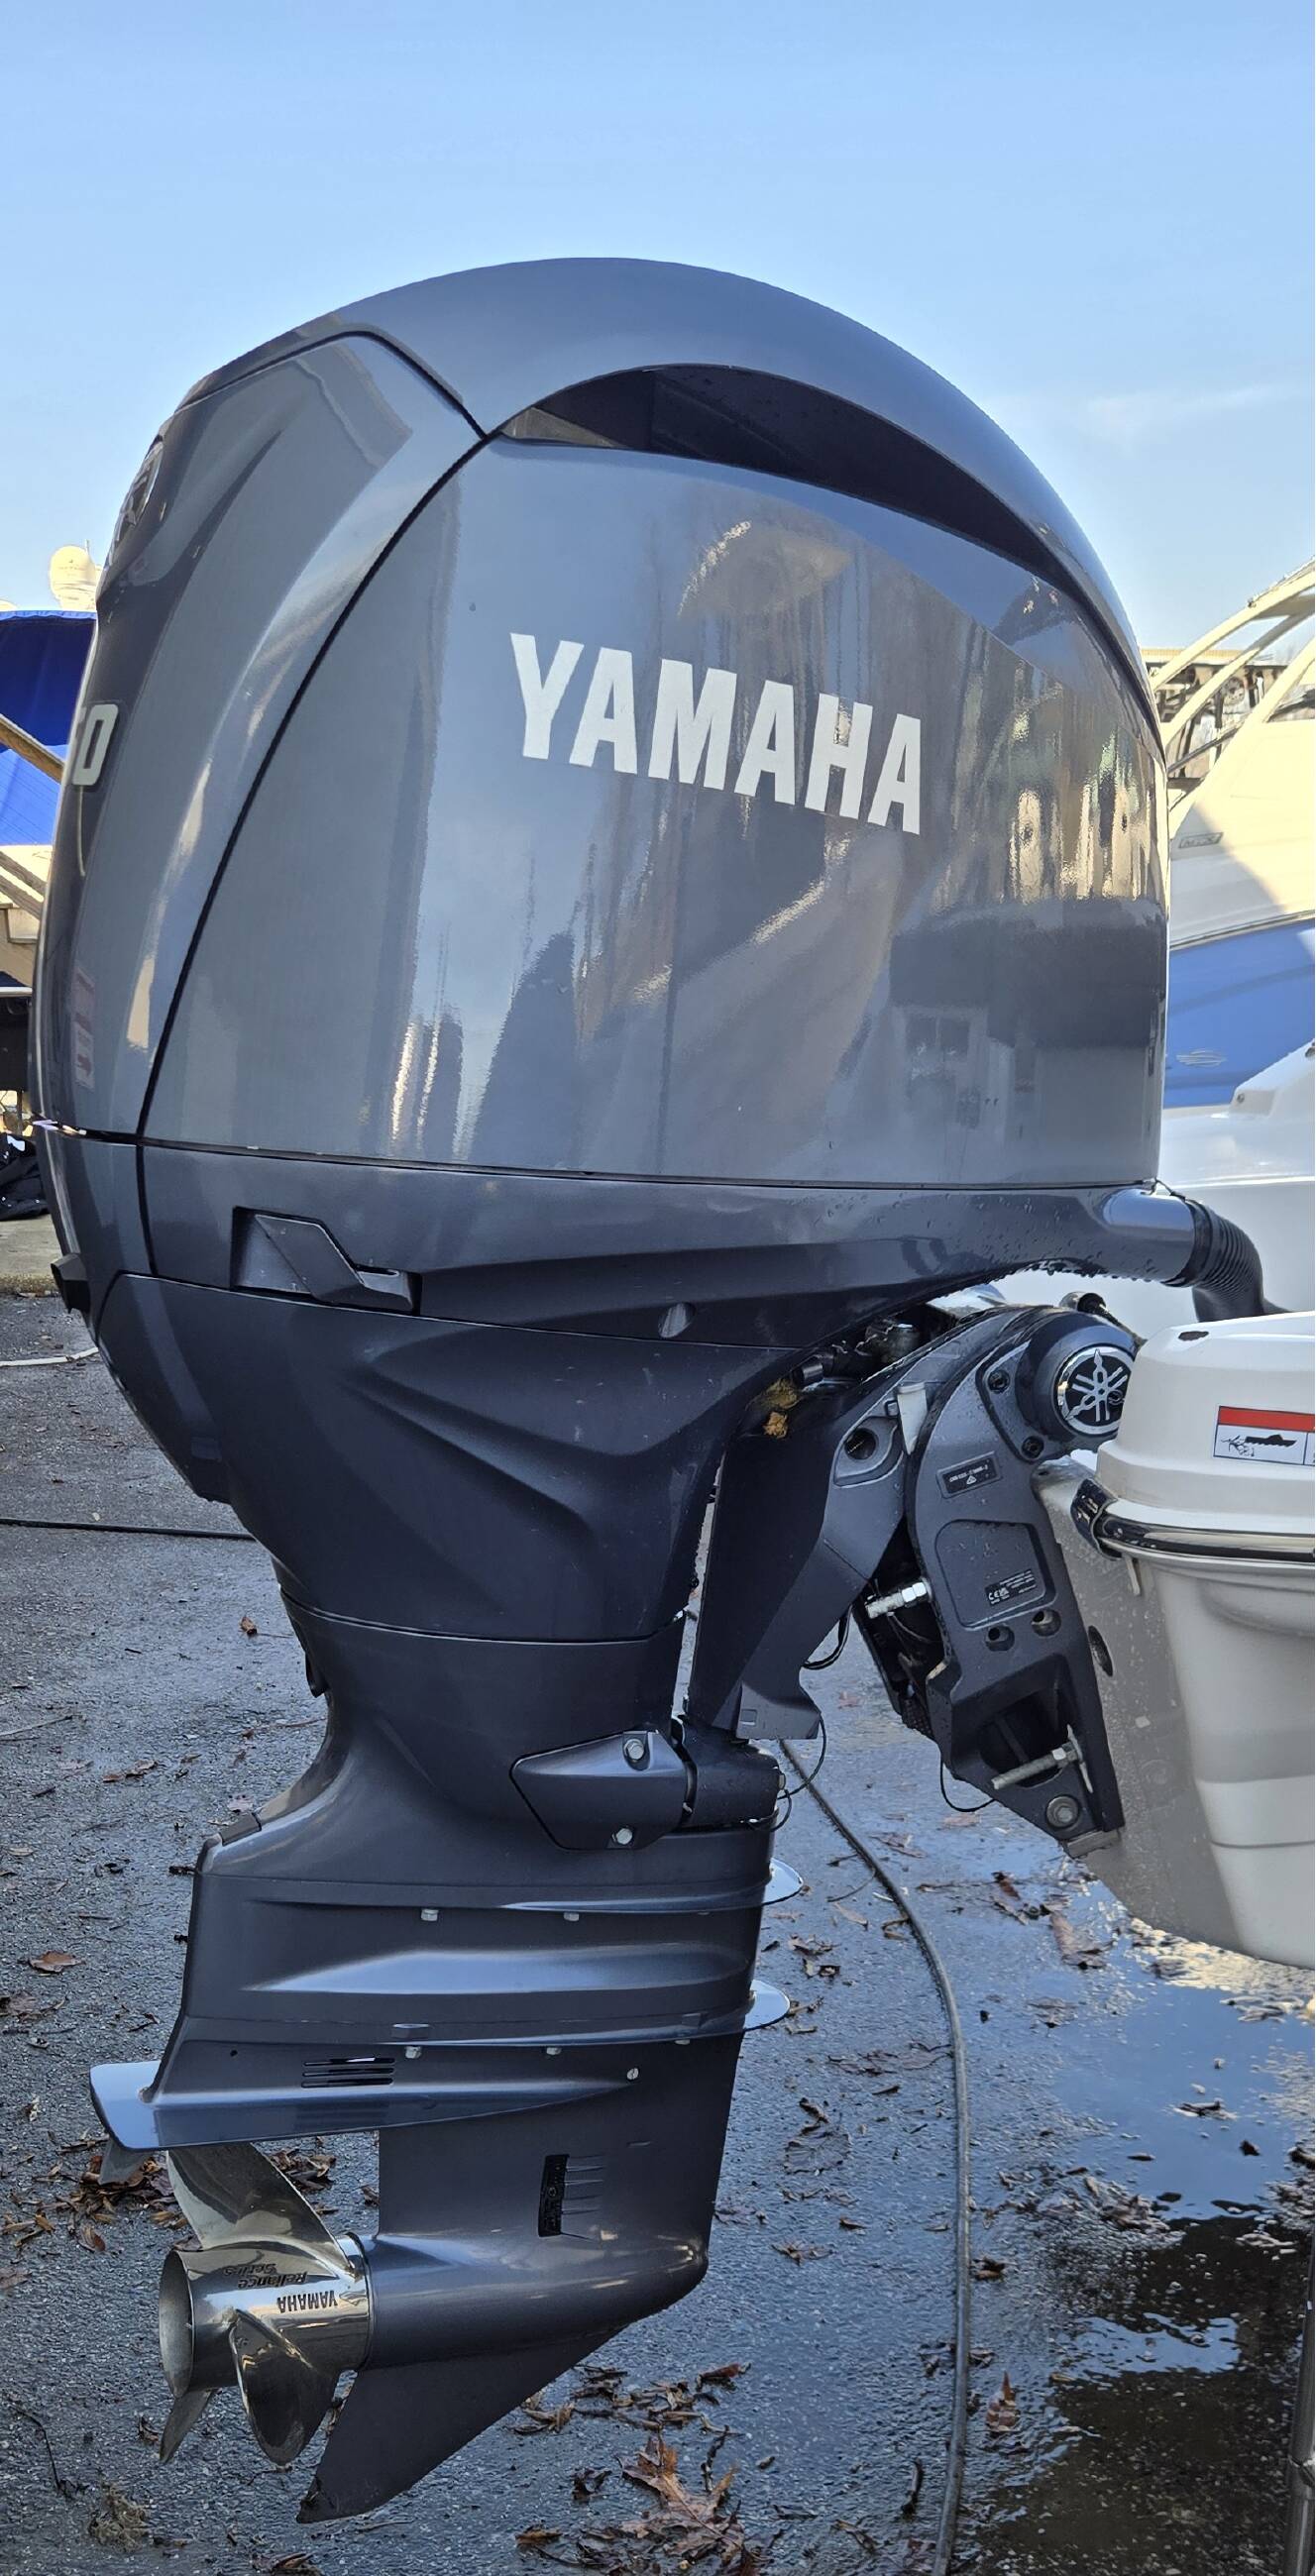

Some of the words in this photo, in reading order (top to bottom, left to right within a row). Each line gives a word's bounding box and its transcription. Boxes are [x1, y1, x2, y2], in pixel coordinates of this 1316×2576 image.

[509, 632, 921, 835] YAMAHA
[238, 2271, 308, 2289] Reliance
[277, 2290, 339, 2313] YAMAHA
